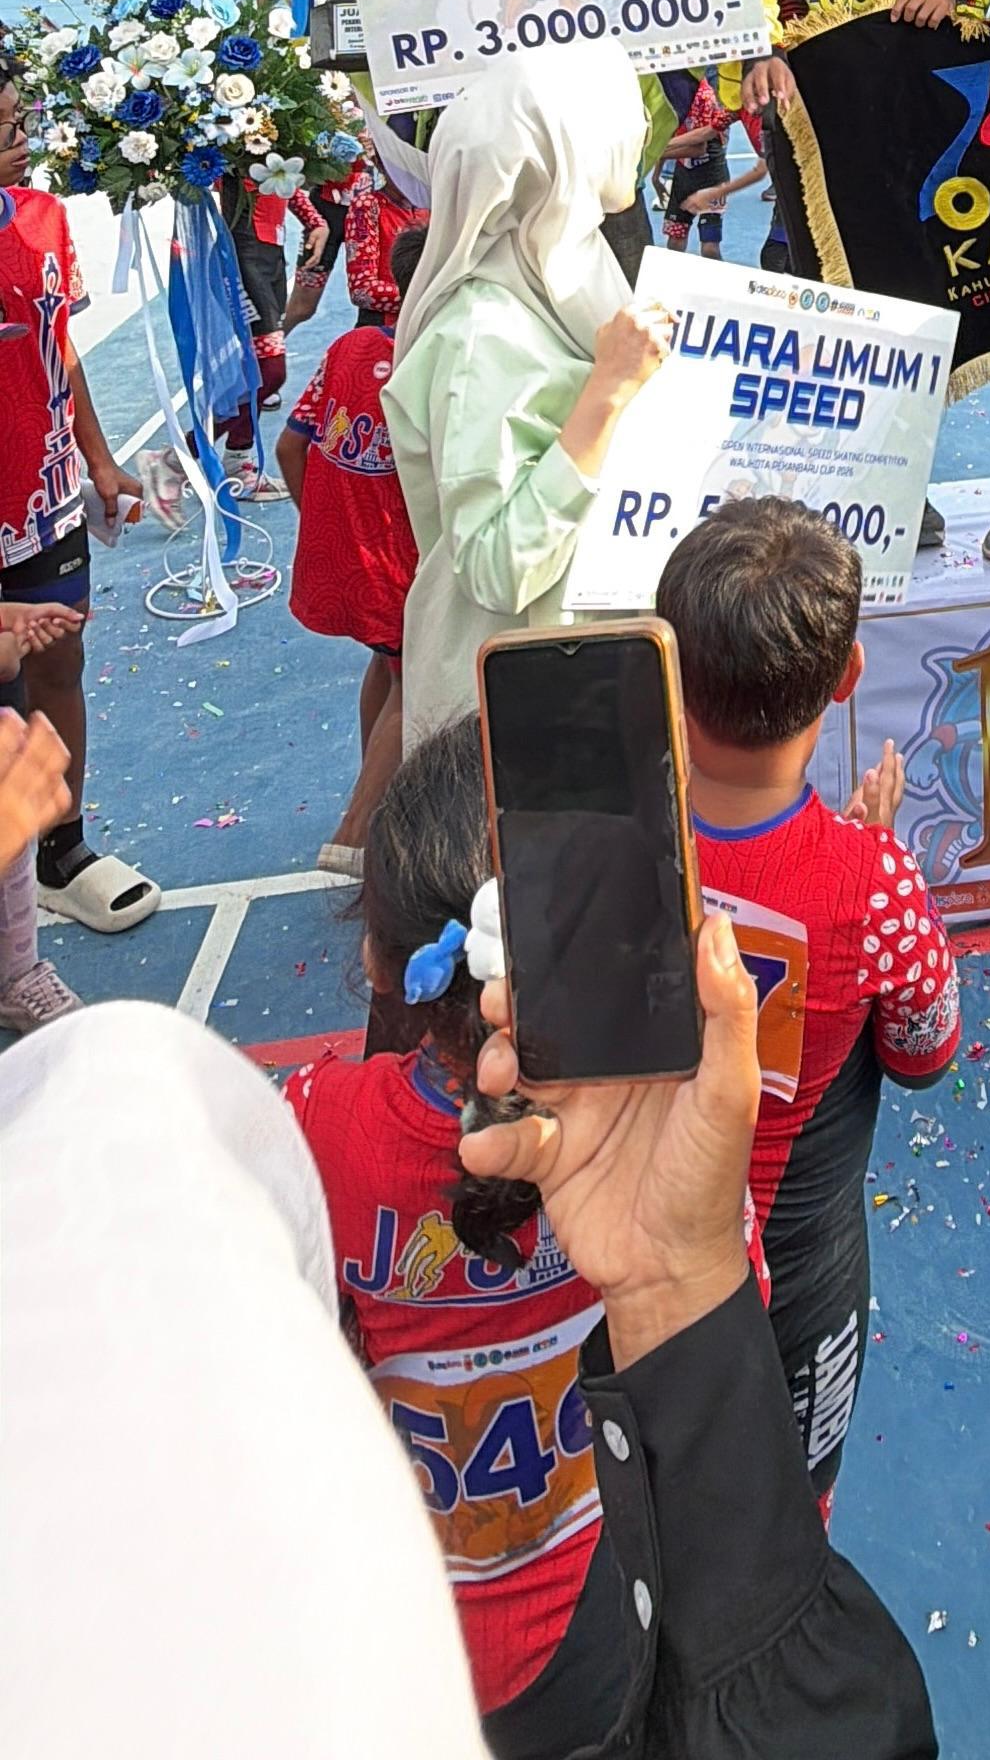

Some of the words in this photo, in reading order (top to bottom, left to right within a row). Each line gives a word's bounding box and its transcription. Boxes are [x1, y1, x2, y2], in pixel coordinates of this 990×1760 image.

[391, 28, 465, 69] RP.
[812, 334, 923, 392] UMUM
[929, 354, 941, 395] 1
[729, 372, 866, 431] SPEED
[721, 440, 744, 451] OPEN
[747, 443, 805, 458] INTERNASIONAL
[808, 448, 833, 460] SPEED
[834, 450, 864, 463] SKATING
[864, 453, 908, 467] COMPETITION
[729, 458, 770, 470] WALIKOTA
[771, 460, 819, 475] PEKANBARU
[820, 463, 836, 476] CUP
[612, 489, 679, 539] RP.
